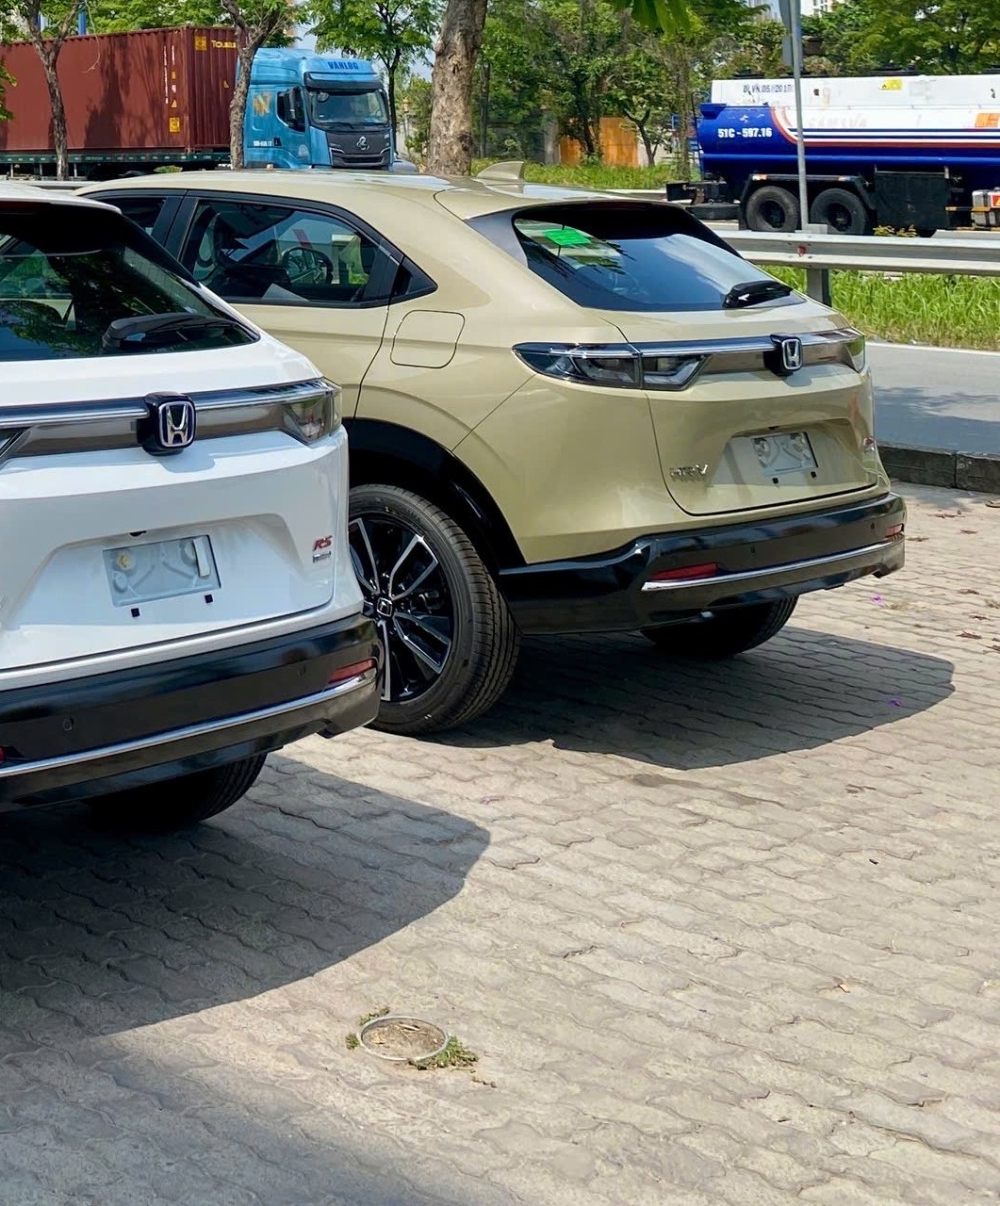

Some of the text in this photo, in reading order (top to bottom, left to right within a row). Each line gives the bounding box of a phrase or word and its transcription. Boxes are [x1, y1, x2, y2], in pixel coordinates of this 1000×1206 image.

[717, 128, 735, 138] 51C
[742, 127, 772, 138] 597.16
[312, 535, 333, 551] RS
